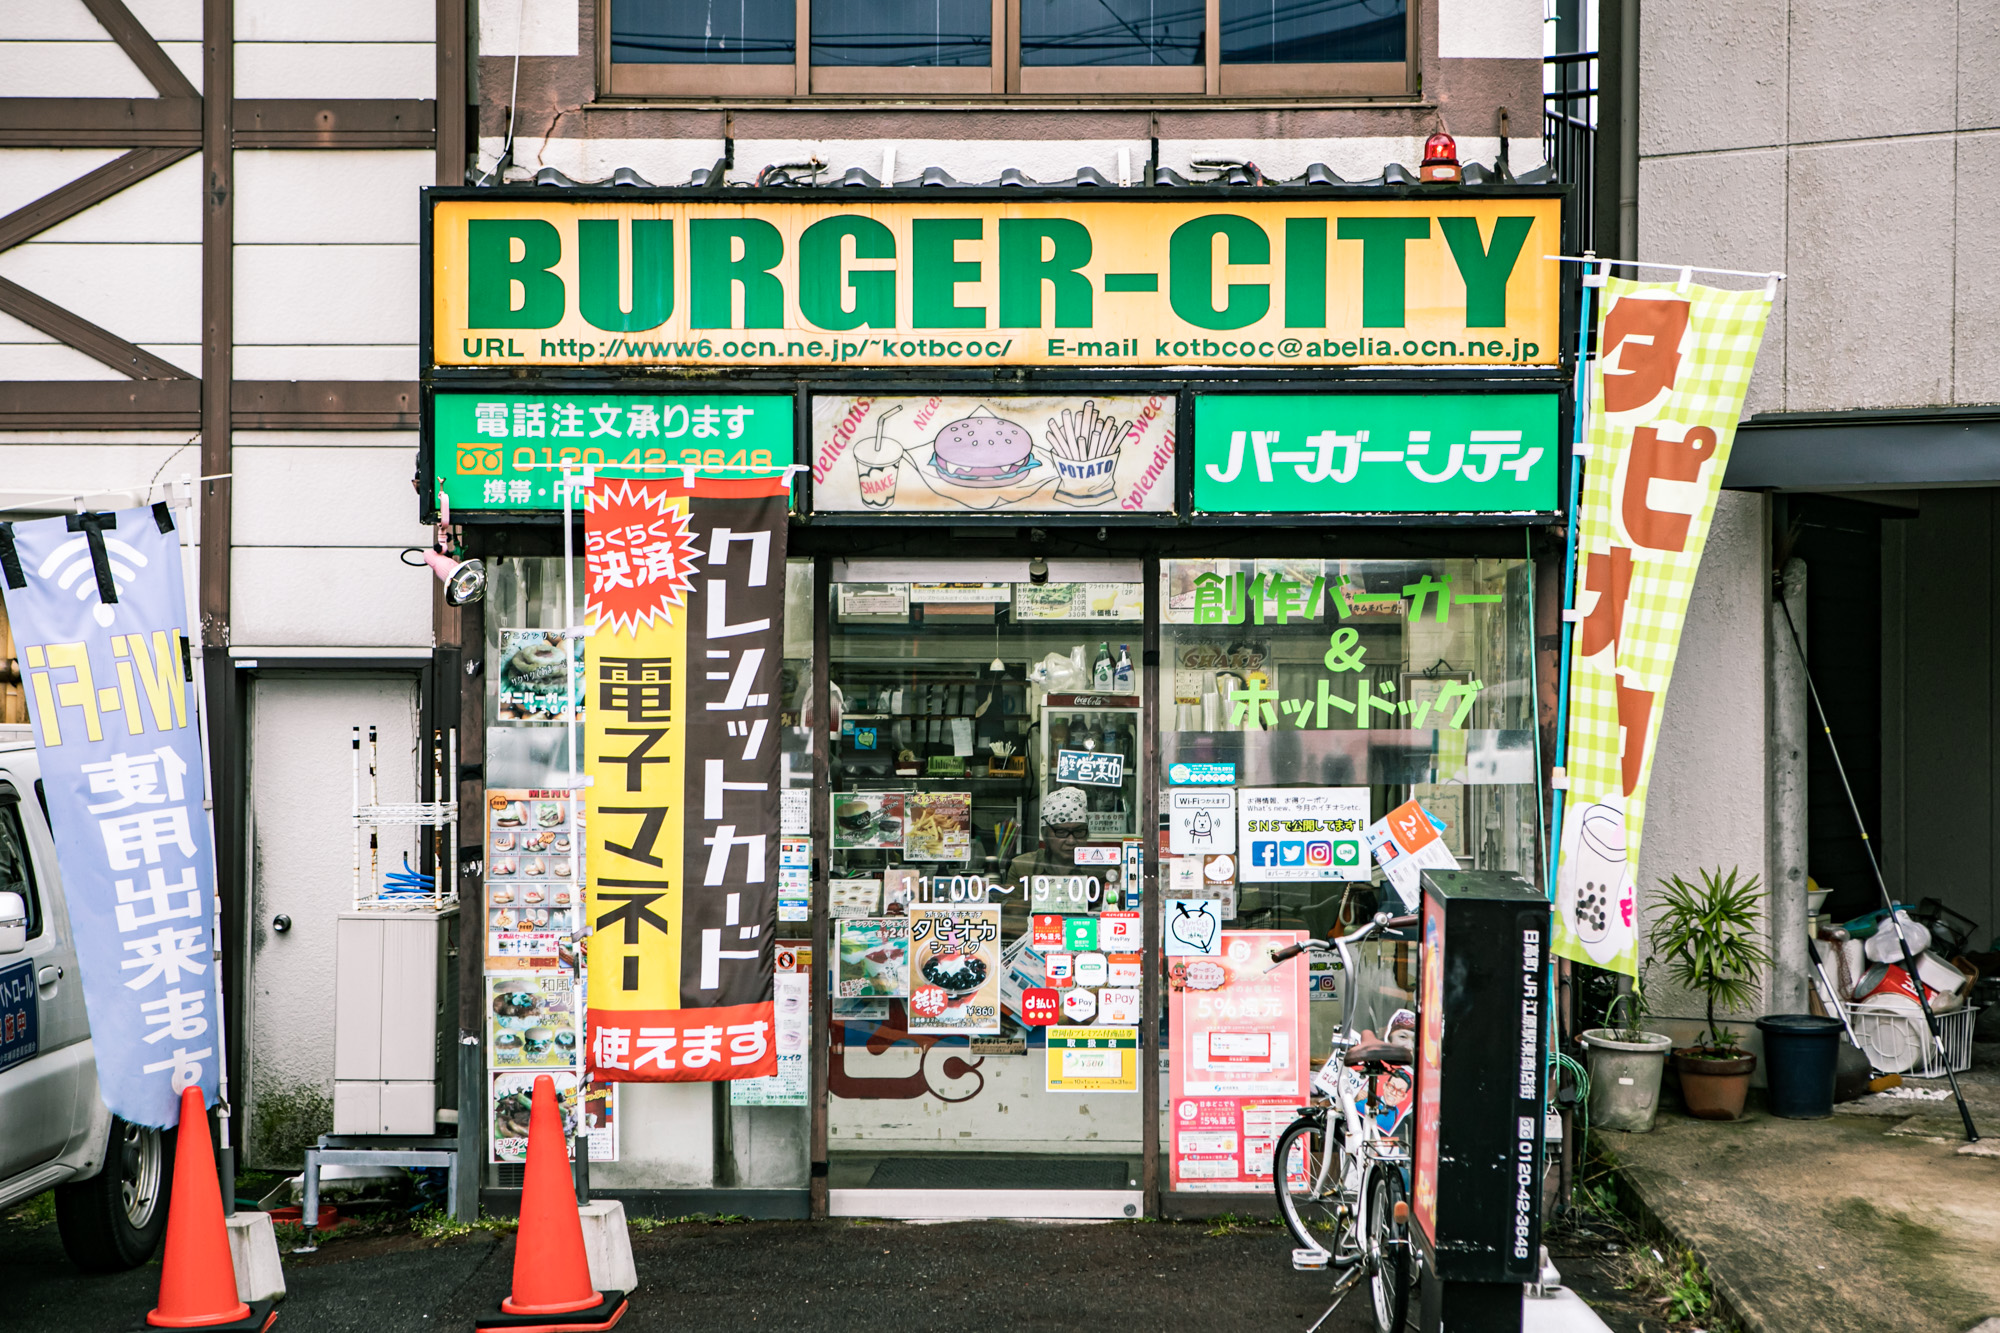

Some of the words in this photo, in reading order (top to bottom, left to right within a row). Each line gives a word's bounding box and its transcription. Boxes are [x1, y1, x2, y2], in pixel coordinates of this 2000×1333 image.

[467, 213, 1535, 332] BURGER-CITY
[463, 337, 525, 358] URL
[1047, 337, 1139, 358] E-mail
[1154, 336, 1541, 362] kotbcoc@abelia.ocn.ne.jp
[475, 402, 754, 440] 電話注文承ります
[513, 446, 774, 474] 0120-42-3648
[1058, 458, 1113, 479] POTATO
[1206, 429, 1544, 484] バーガーシティ
[860, 473, 895, 494] SHAKE
[585, 519, 668, 551] らくらく
[586, 540, 677, 593] 決済
[1193, 571, 1502, 625] 創作バーガー
[1184, 654, 1262, 670] SHAKE
[1324, 627, 1367, 673] &
[1228, 679, 1484, 730] ホットドッグ
[700, 527, 771, 990] クレジットカード
[1076, 755, 1121, 784] 営業中
[596, 657, 671, 991] 電子マネー
[911, 918, 997, 942] タピオカ
[930, 941, 980, 954] シェイク
[1115, 994, 1134, 1005] Pay
[1523, 975, 1538, 998] JR
[966, 1006, 994, 1016] ¥360
[1025, 996, 1056, 1009] d払い
[1078, 998, 1092, 1006] Pay
[1198, 997, 1282, 1018] 5%還元
[593, 1020, 769, 1071] 使えます
